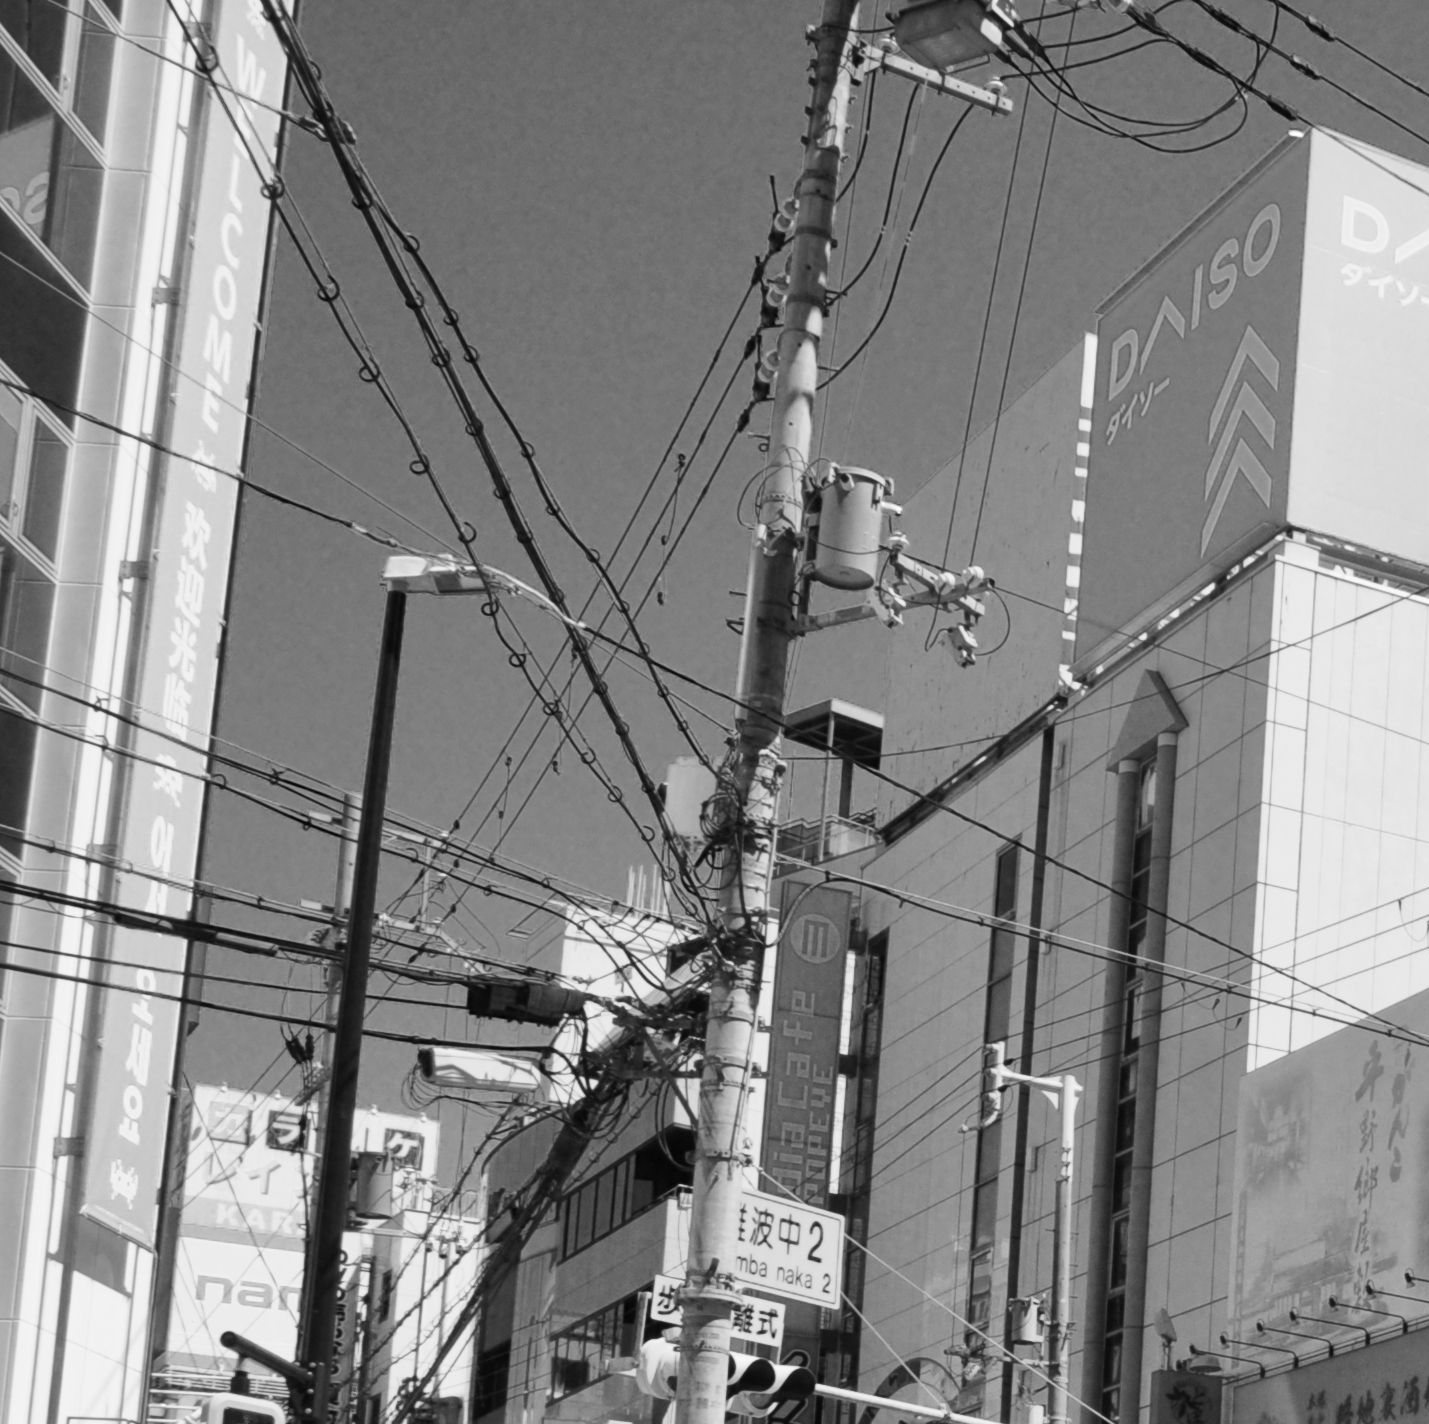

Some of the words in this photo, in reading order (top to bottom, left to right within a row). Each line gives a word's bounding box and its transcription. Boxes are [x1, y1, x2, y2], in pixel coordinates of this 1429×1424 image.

[1108, 202, 1282, 402] DAISO
[1107, 377, 1170, 446] ダイソー
[736, 1254, 768, 1278] mba
[776, 1264, 814, 1290] naka
[821, 1273, 832, 1294] 2
